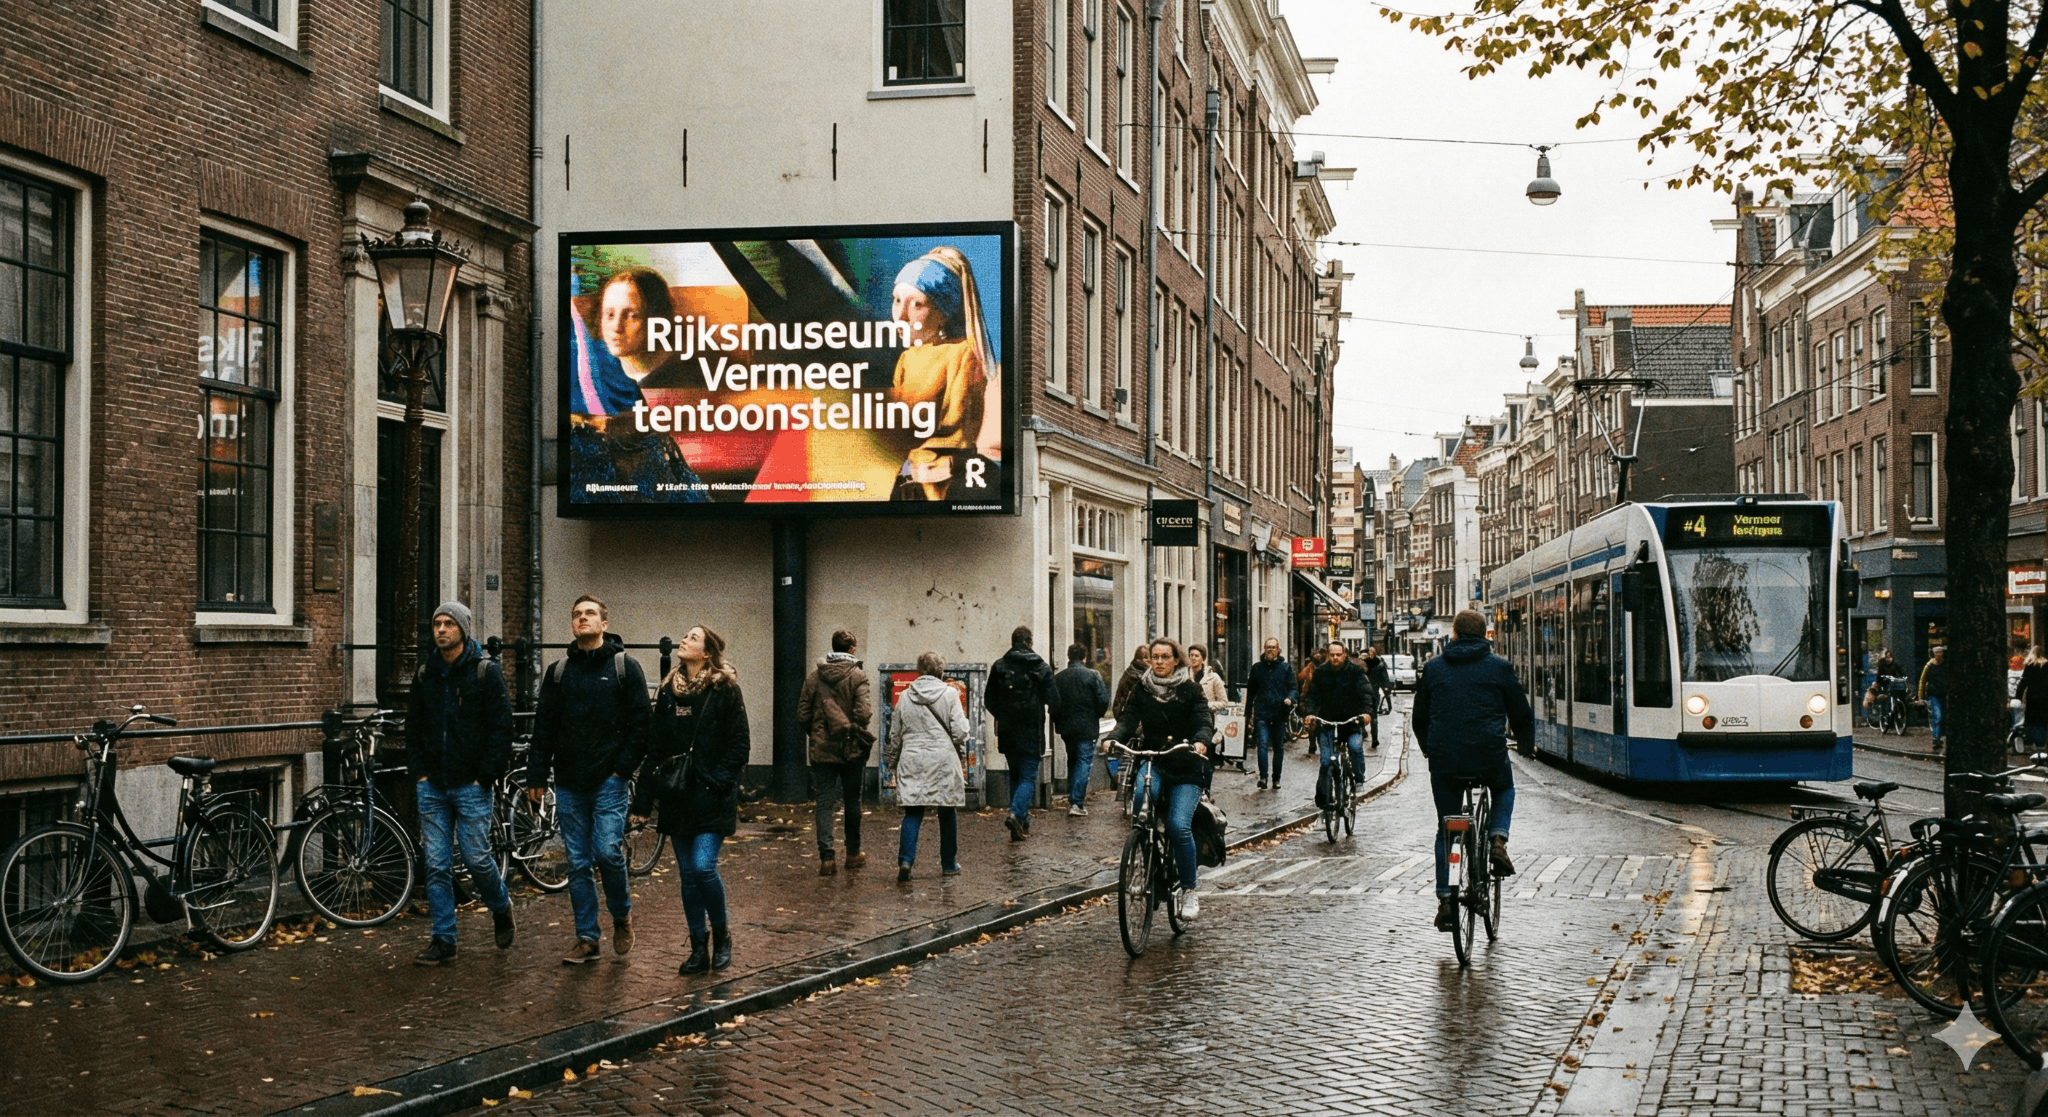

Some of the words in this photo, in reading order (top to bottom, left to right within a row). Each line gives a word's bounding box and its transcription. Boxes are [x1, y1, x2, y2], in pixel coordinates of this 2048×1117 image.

[647, 315, 923, 361] Rijksmuseum:
[699, 357, 869, 391] Vermeer
[632, 393, 937, 438] tentoonstelling
[965, 458, 987, 488] R
